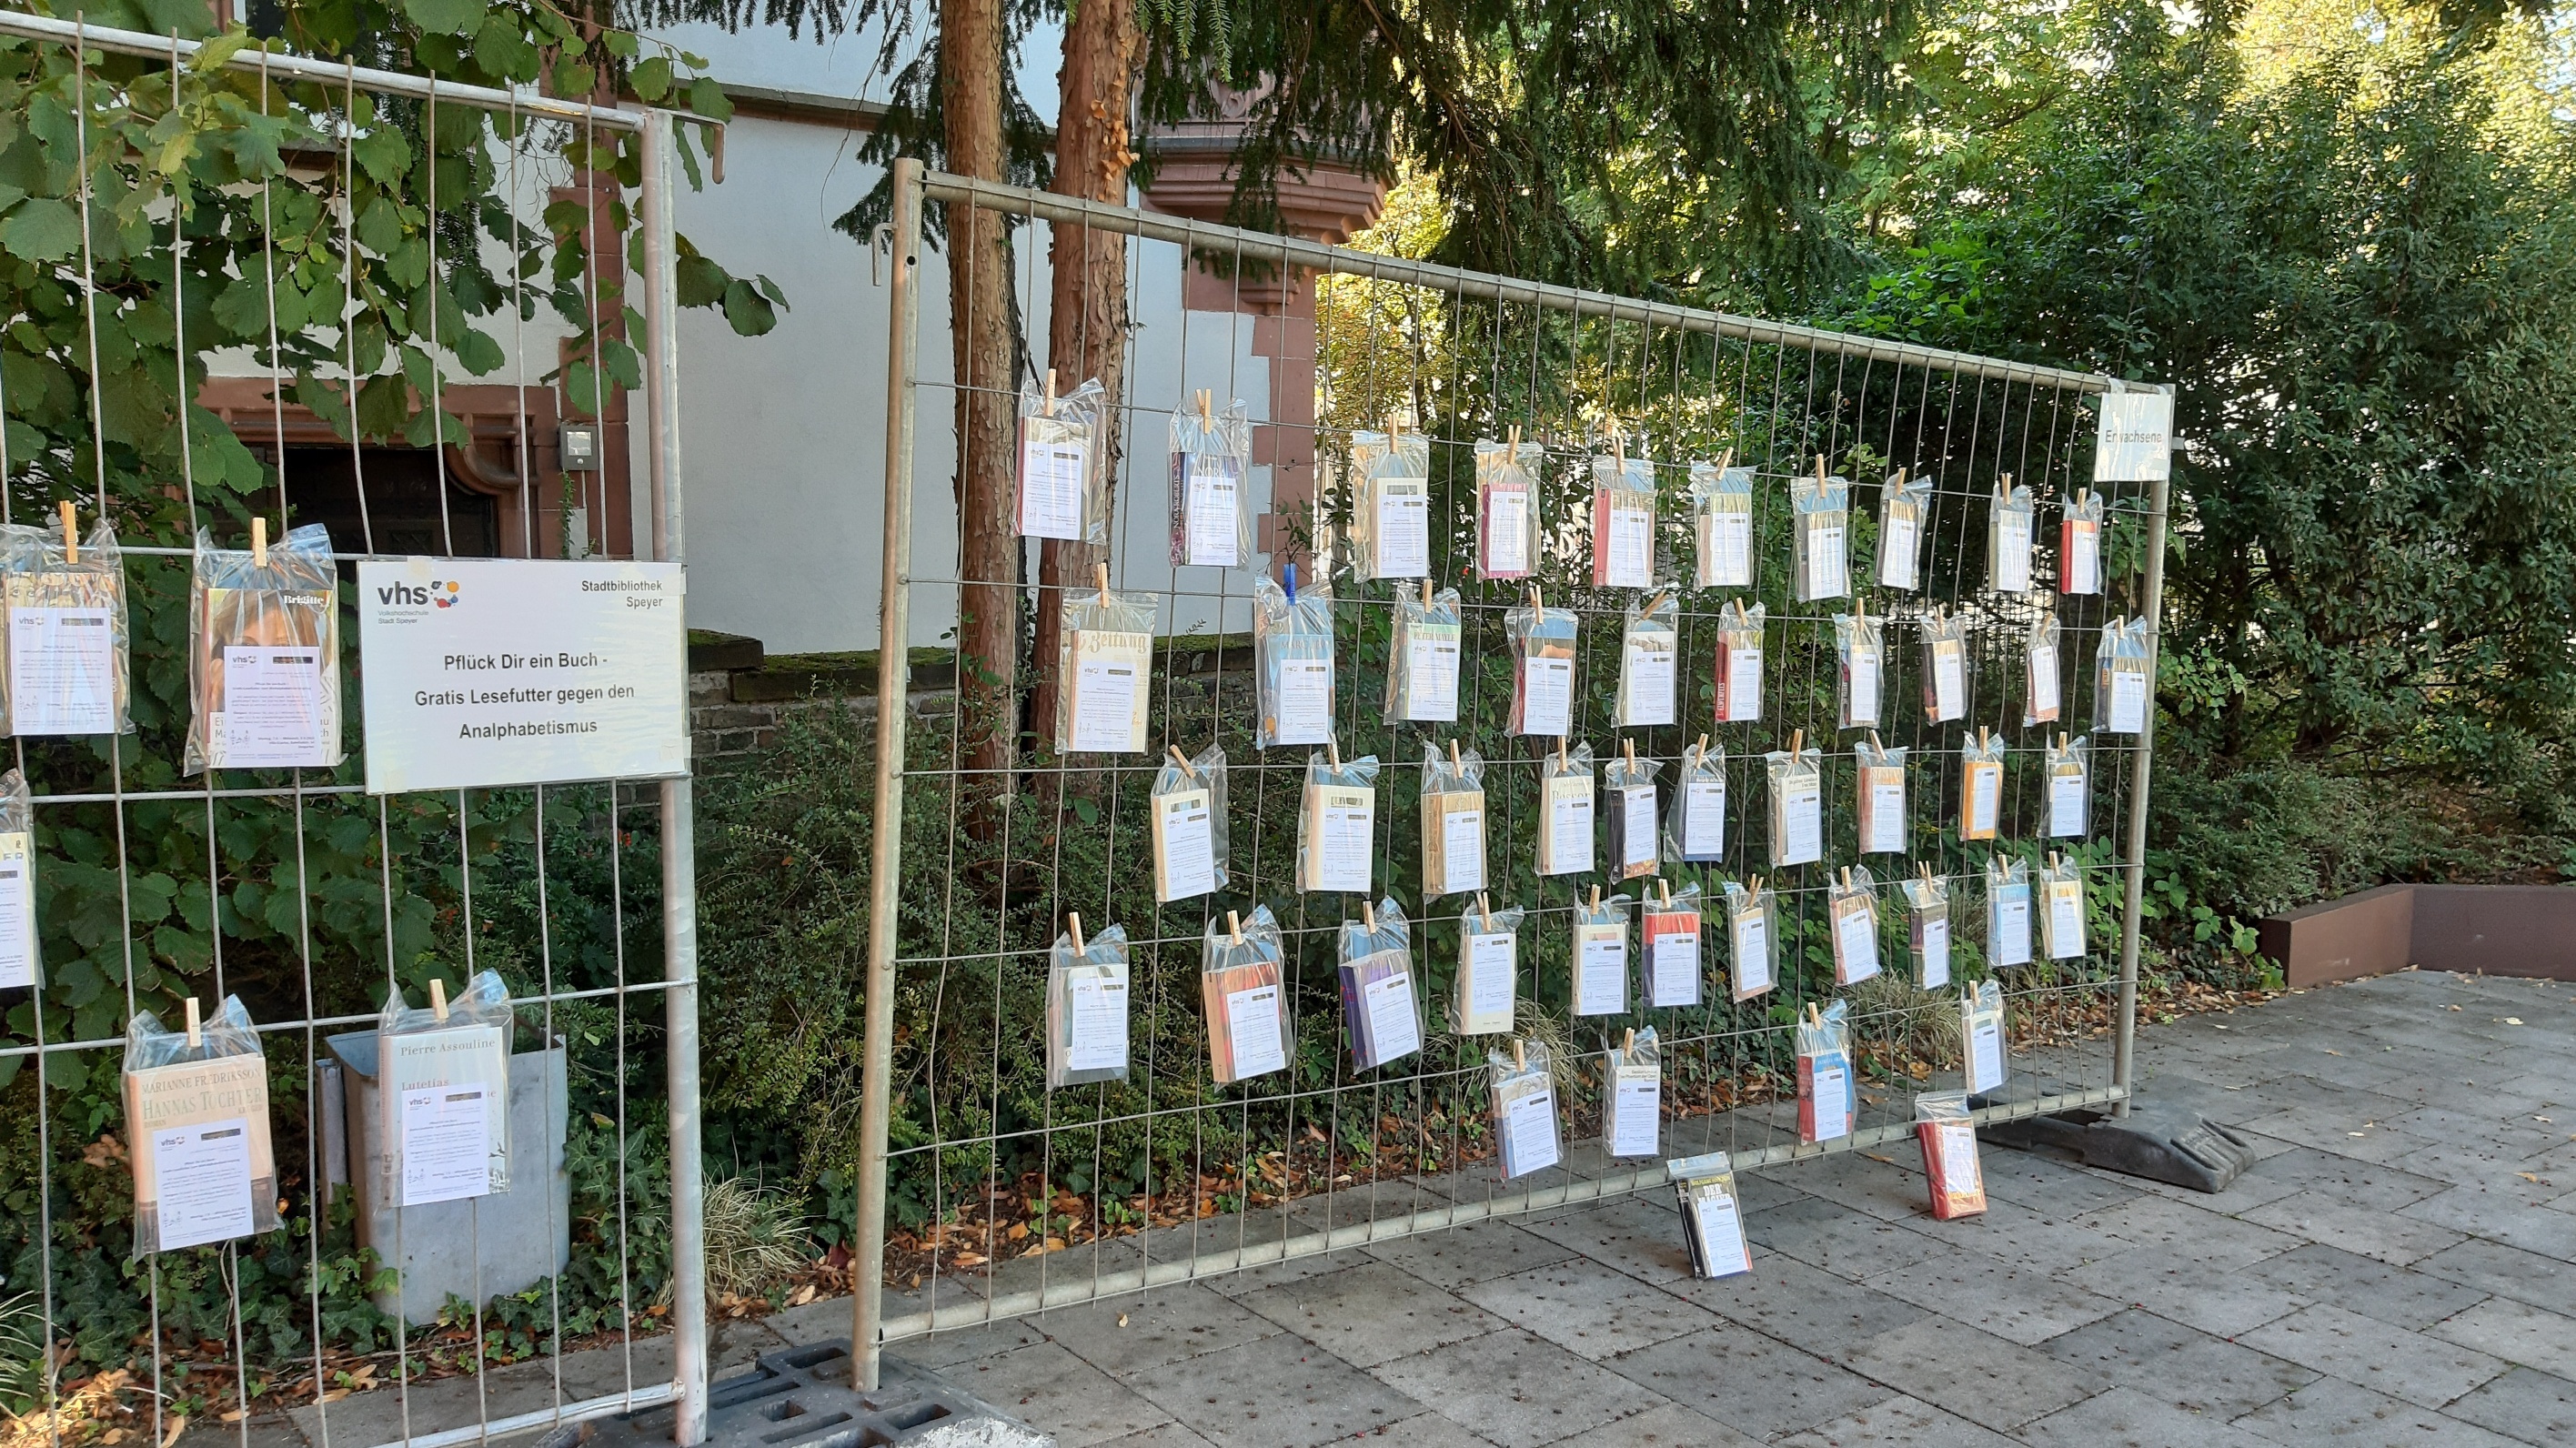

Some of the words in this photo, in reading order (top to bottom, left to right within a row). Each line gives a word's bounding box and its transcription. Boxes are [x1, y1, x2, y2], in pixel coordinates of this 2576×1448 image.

[2105, 430, 2162, 443] Erwachsene
[581, 580, 662, 592] Stadtbibliothek
[377, 580, 428, 606] vhs
[284, 594, 326, 607] Brigitte
[626, 597, 663, 609] Speyer
[18, 617, 35, 625] vhs
[232, 655, 247, 663] vhs
[444, 654, 497, 670] Pflück
[501, 653, 525, 669] Dir
[529, 653, 553, 669] ein
[558, 652, 599, 668] Buch
[415, 690, 465, 707] Gratis
[470, 688, 552, 704] Lesefutter
[557, 687, 603, 704] gegen
[607, 684, 635, 699] den
[458, 719, 599, 741] Analphabetismus
[400, 1046, 437, 1057] Pierre
[438, 1039, 497, 1053] Assouline
[401, 1078, 449, 1091] Lutetias
[143, 1096, 196, 1120] HANNAS
[199, 1087, 263, 1111] TOCHTER
[408, 1097, 423, 1106] vhs
[161, 1137, 176, 1146] vhs
[1702, 1182, 1723, 1197] DER
